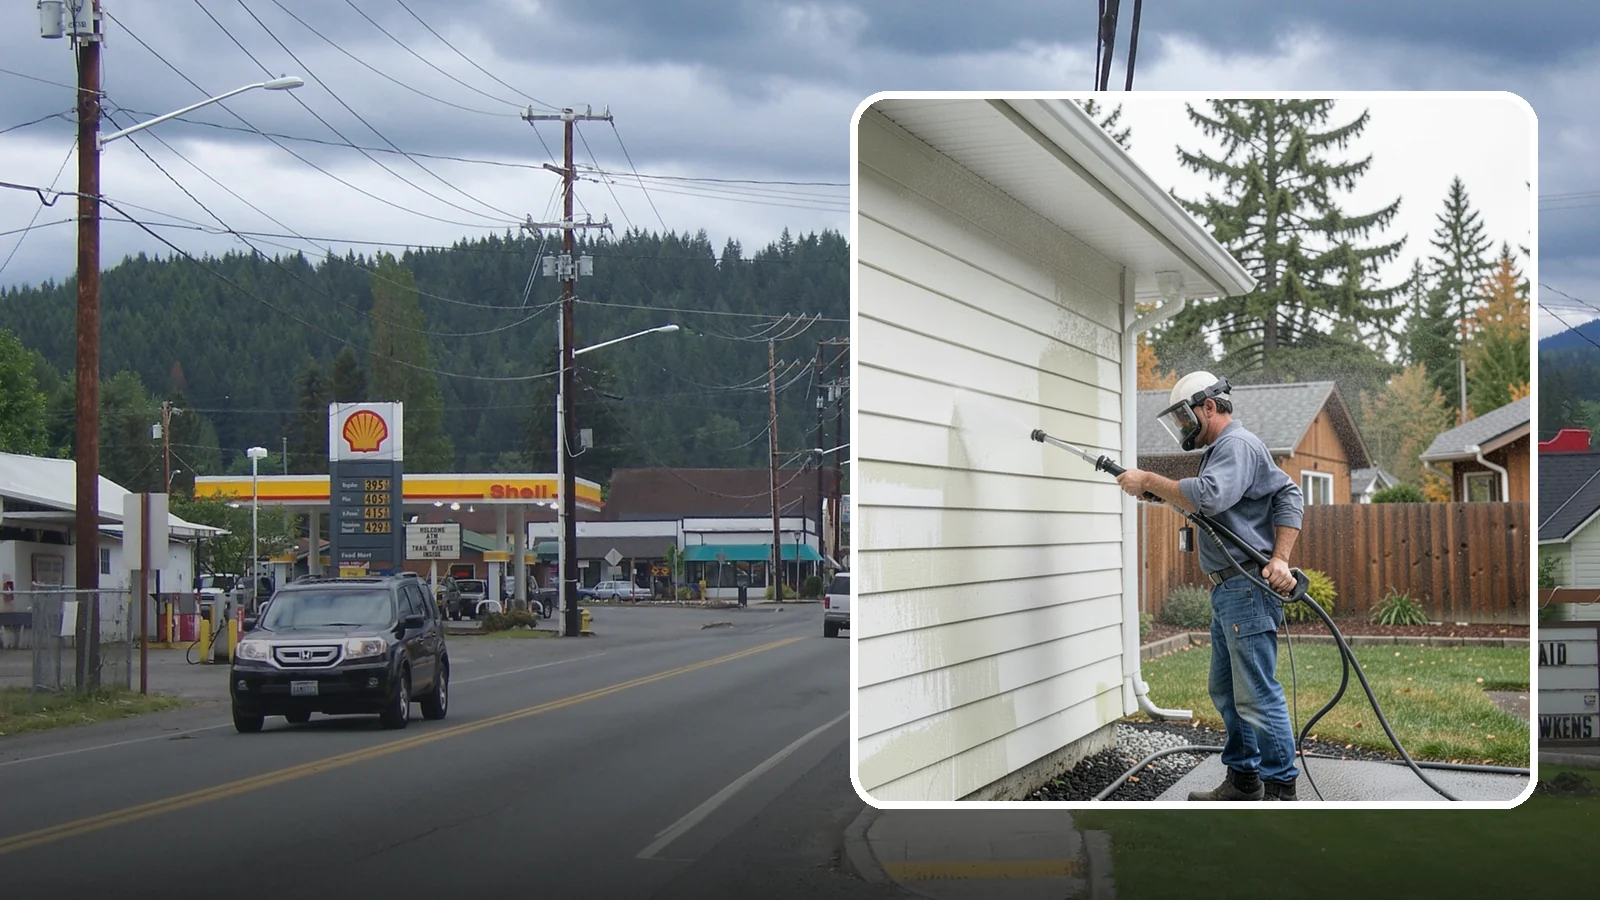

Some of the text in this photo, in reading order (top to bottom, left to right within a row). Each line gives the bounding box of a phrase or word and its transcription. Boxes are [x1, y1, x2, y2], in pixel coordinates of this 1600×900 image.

[365, 480, 384, 490] 395
[490, 484, 547, 499] Shell
[365, 494, 384, 504] 405
[365, 508, 384, 518] 415
[365, 522, 384, 532] 429
